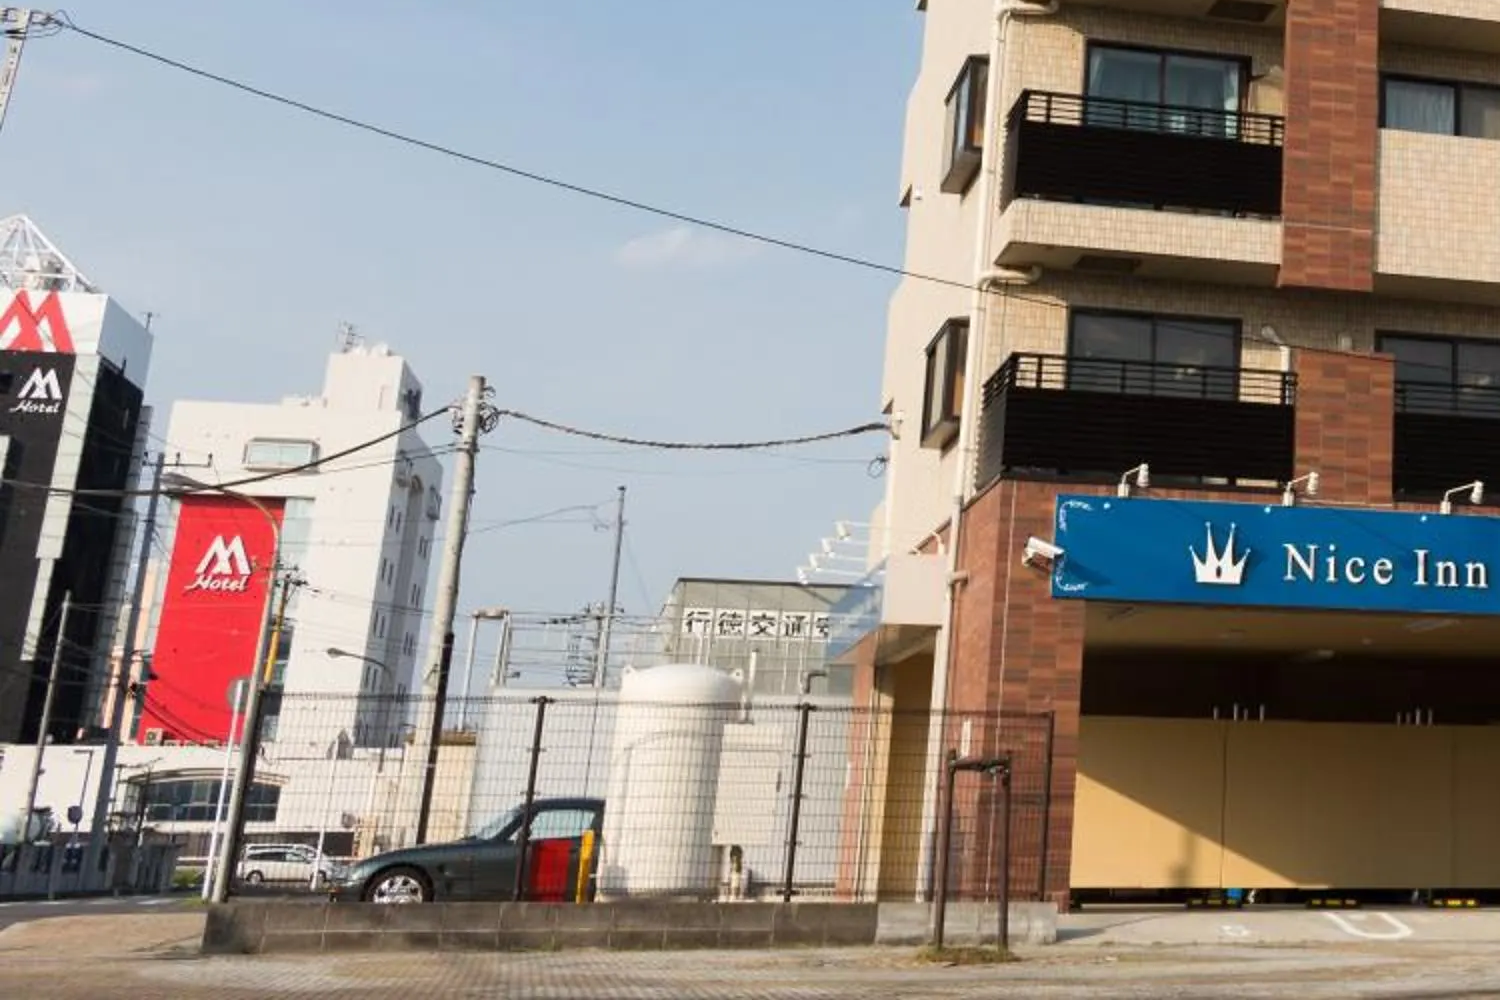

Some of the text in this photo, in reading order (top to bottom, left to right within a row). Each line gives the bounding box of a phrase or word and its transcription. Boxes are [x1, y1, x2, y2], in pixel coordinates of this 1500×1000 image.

[9, 400, 60, 413] Hotel
[1282, 543, 1394, 585] Nice
[1413, 549, 1489, 588] Inn
[184, 574, 249, 592] Hotel
